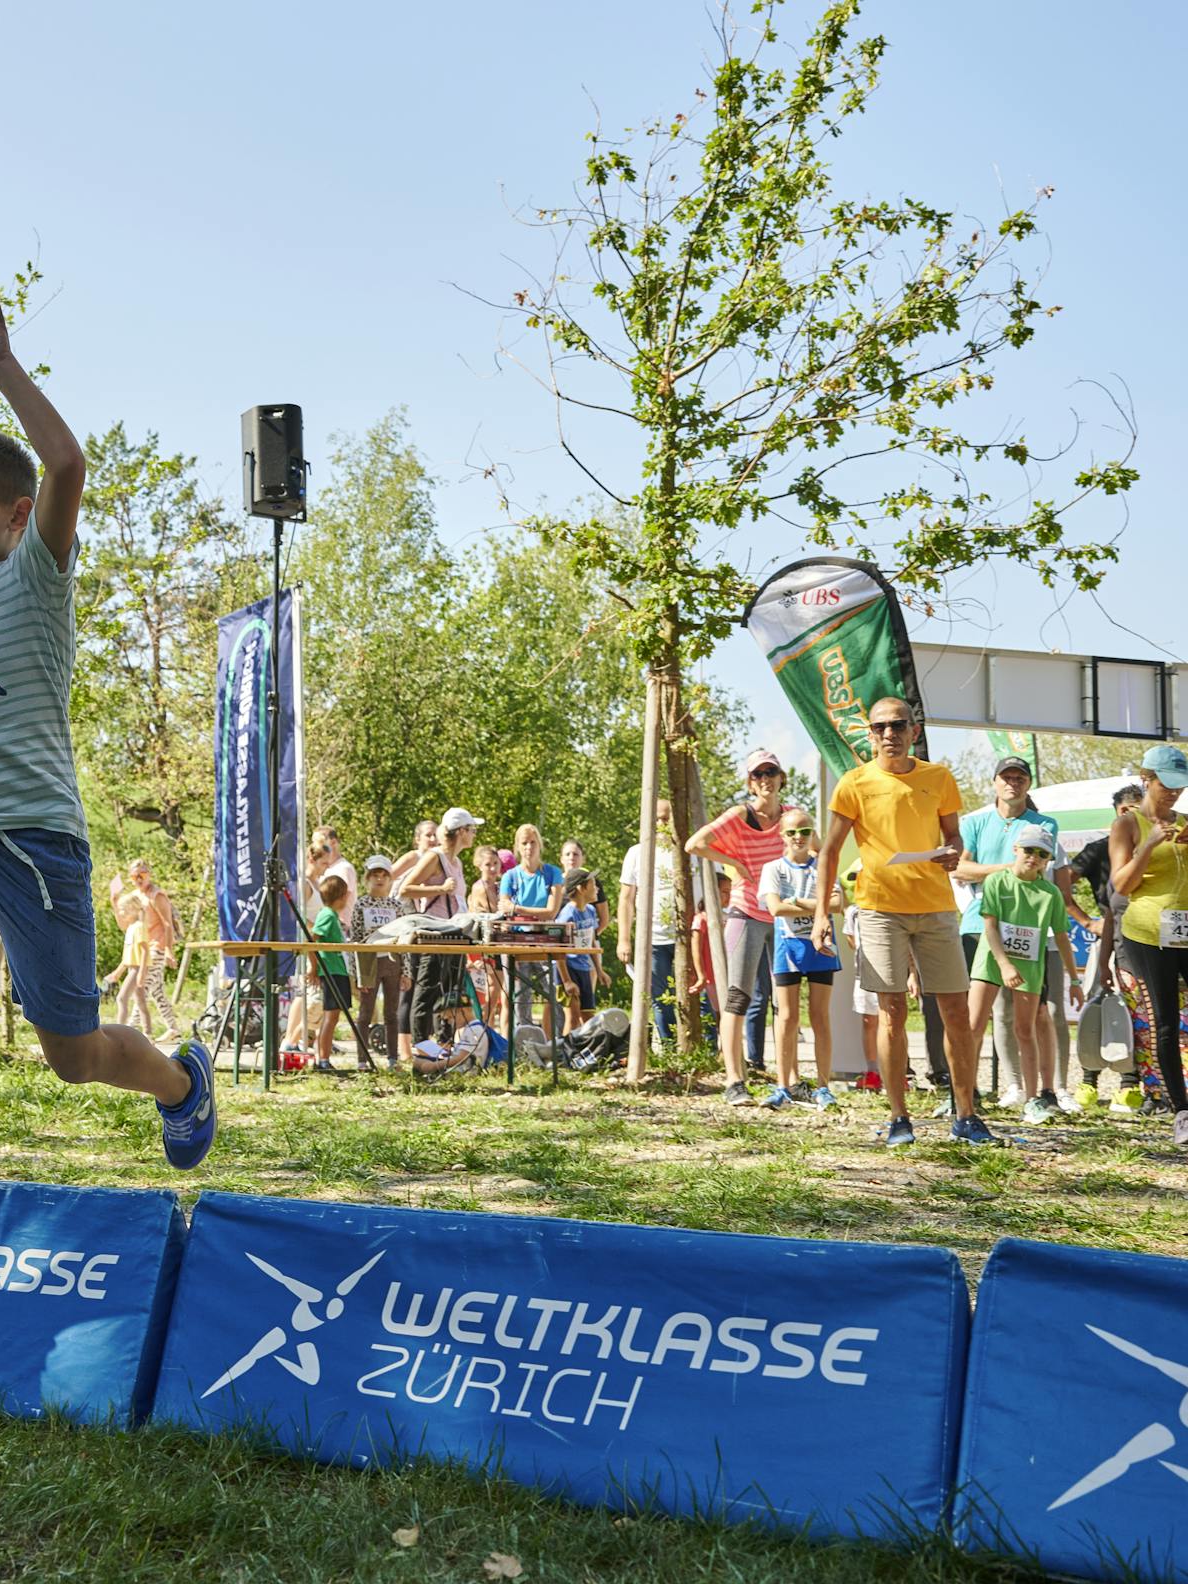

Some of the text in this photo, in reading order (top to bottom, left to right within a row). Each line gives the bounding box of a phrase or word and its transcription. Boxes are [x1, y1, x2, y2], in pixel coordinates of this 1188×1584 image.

[801, 587, 841, 606] UBS
[821, 650, 851, 706] UBS
[372, 915, 390, 924] 470
[1015, 927, 1034, 938] UBS
[1003, 937, 1030, 952] 455
[380, 1281, 880, 1386] WELTKLASSE
[356, 1343, 644, 1431] ZÜRICH
